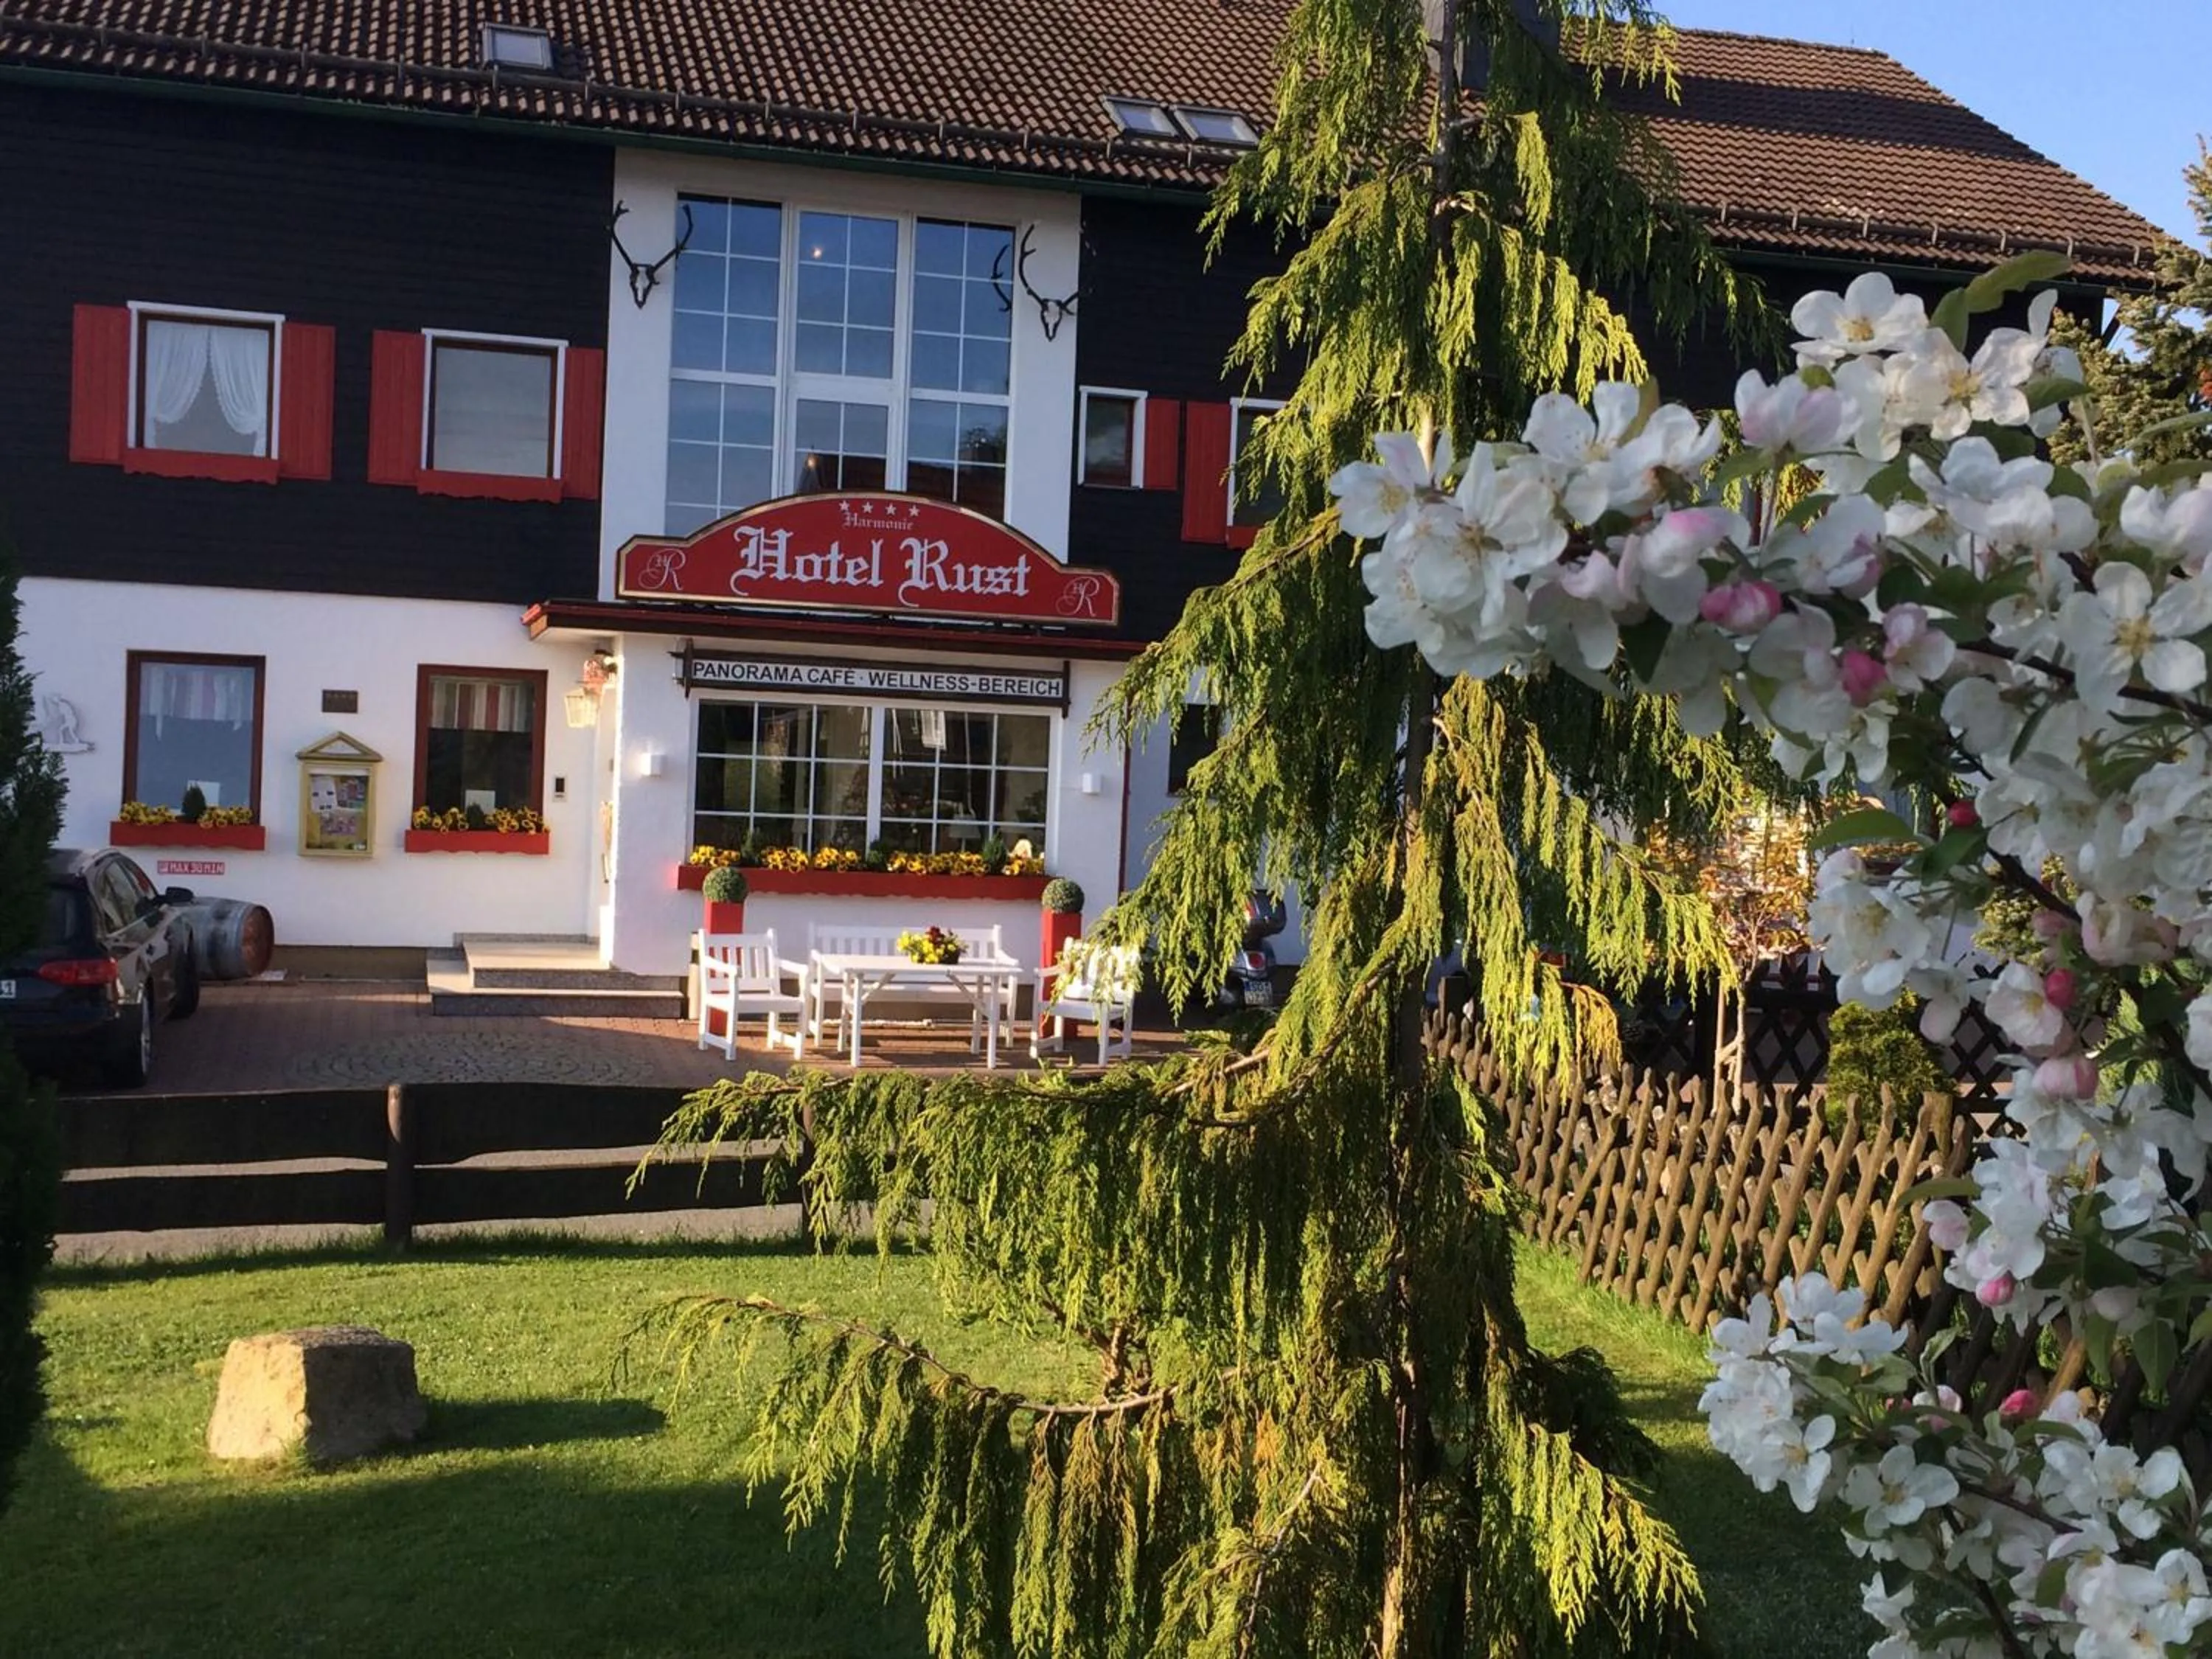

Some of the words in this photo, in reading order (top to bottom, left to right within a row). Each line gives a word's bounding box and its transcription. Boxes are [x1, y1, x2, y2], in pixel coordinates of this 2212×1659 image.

[842, 510, 914, 530] Harmonie
[730, 525, 884, 597] Hotel
[897, 537, 1031, 608] Rust
[693, 661, 803, 682] PANORAMA
[869, 671, 1060, 695] WELLNESS-BEREICH
